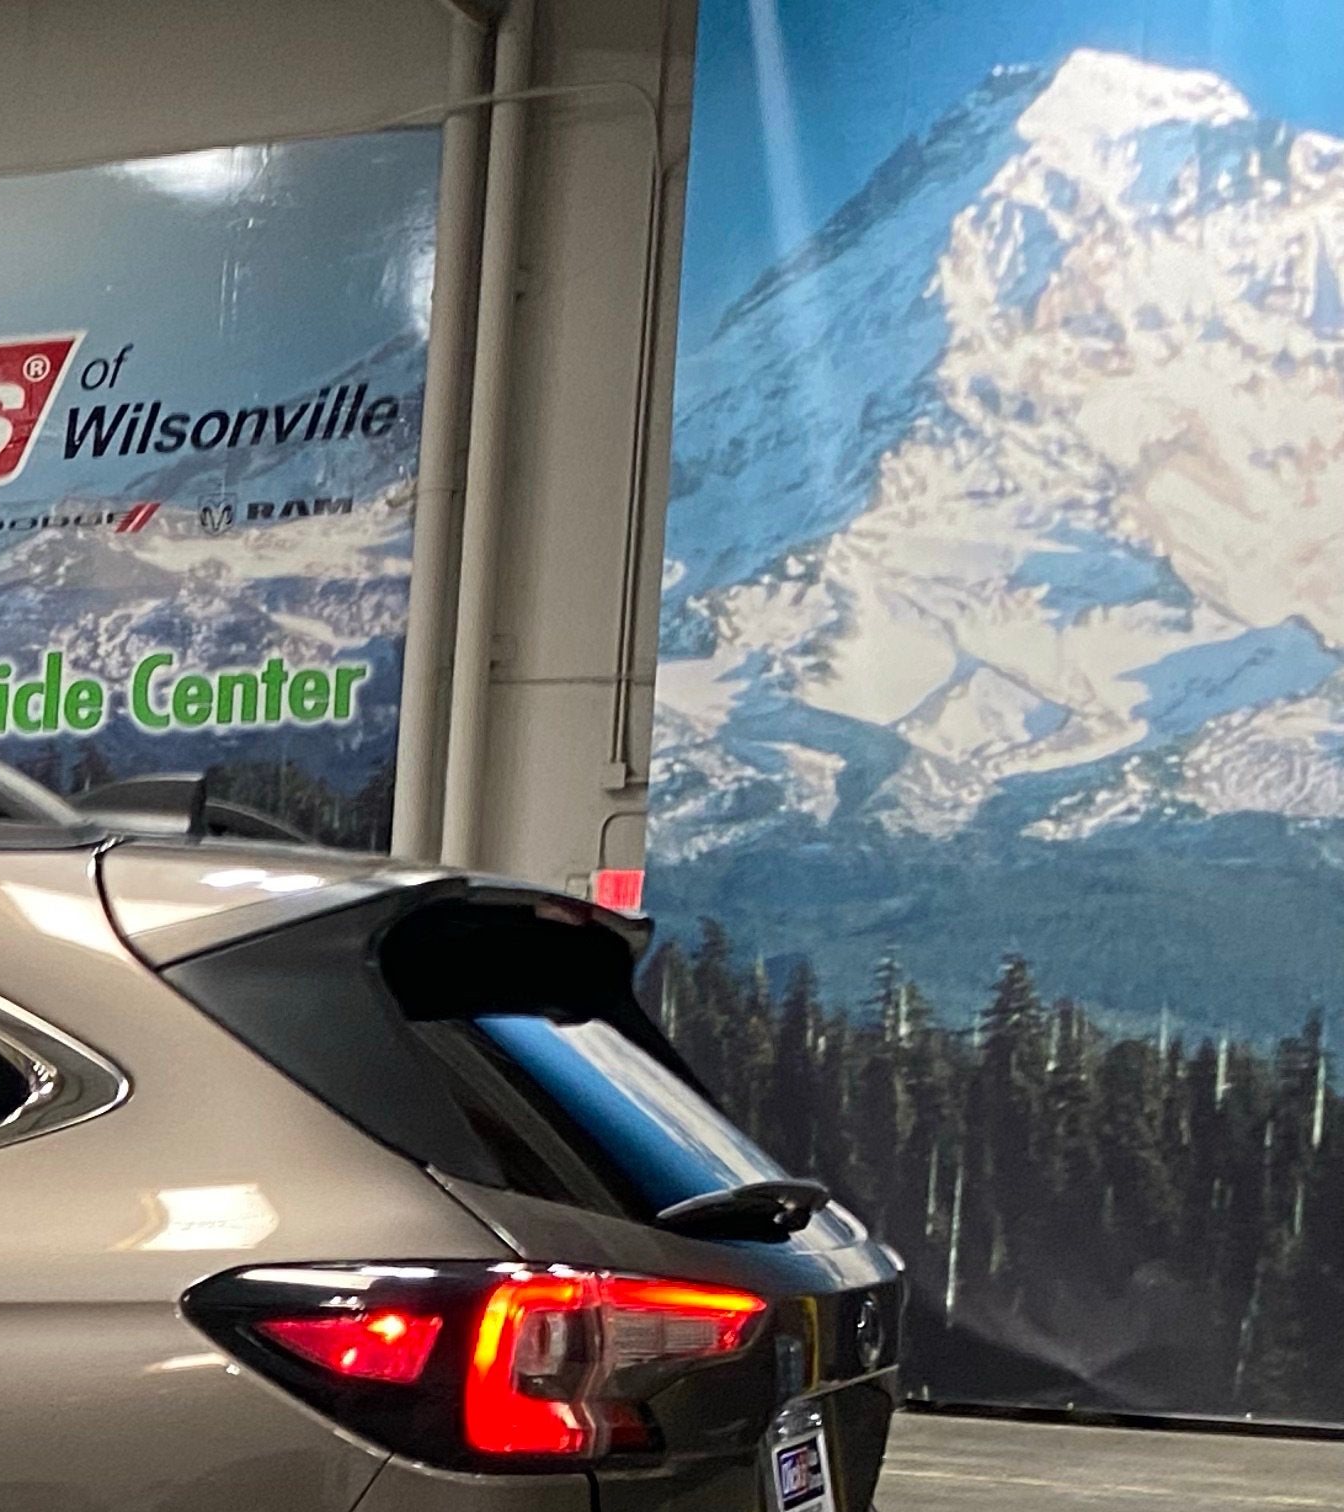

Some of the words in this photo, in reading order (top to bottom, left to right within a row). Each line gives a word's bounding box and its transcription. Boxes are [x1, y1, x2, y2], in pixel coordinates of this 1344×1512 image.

[81, 343, 134, 391] of
[64, 383, 399, 460] Wilsonville
[247, 497, 354, 522] RAM
[132, 653, 367, 728] Center
